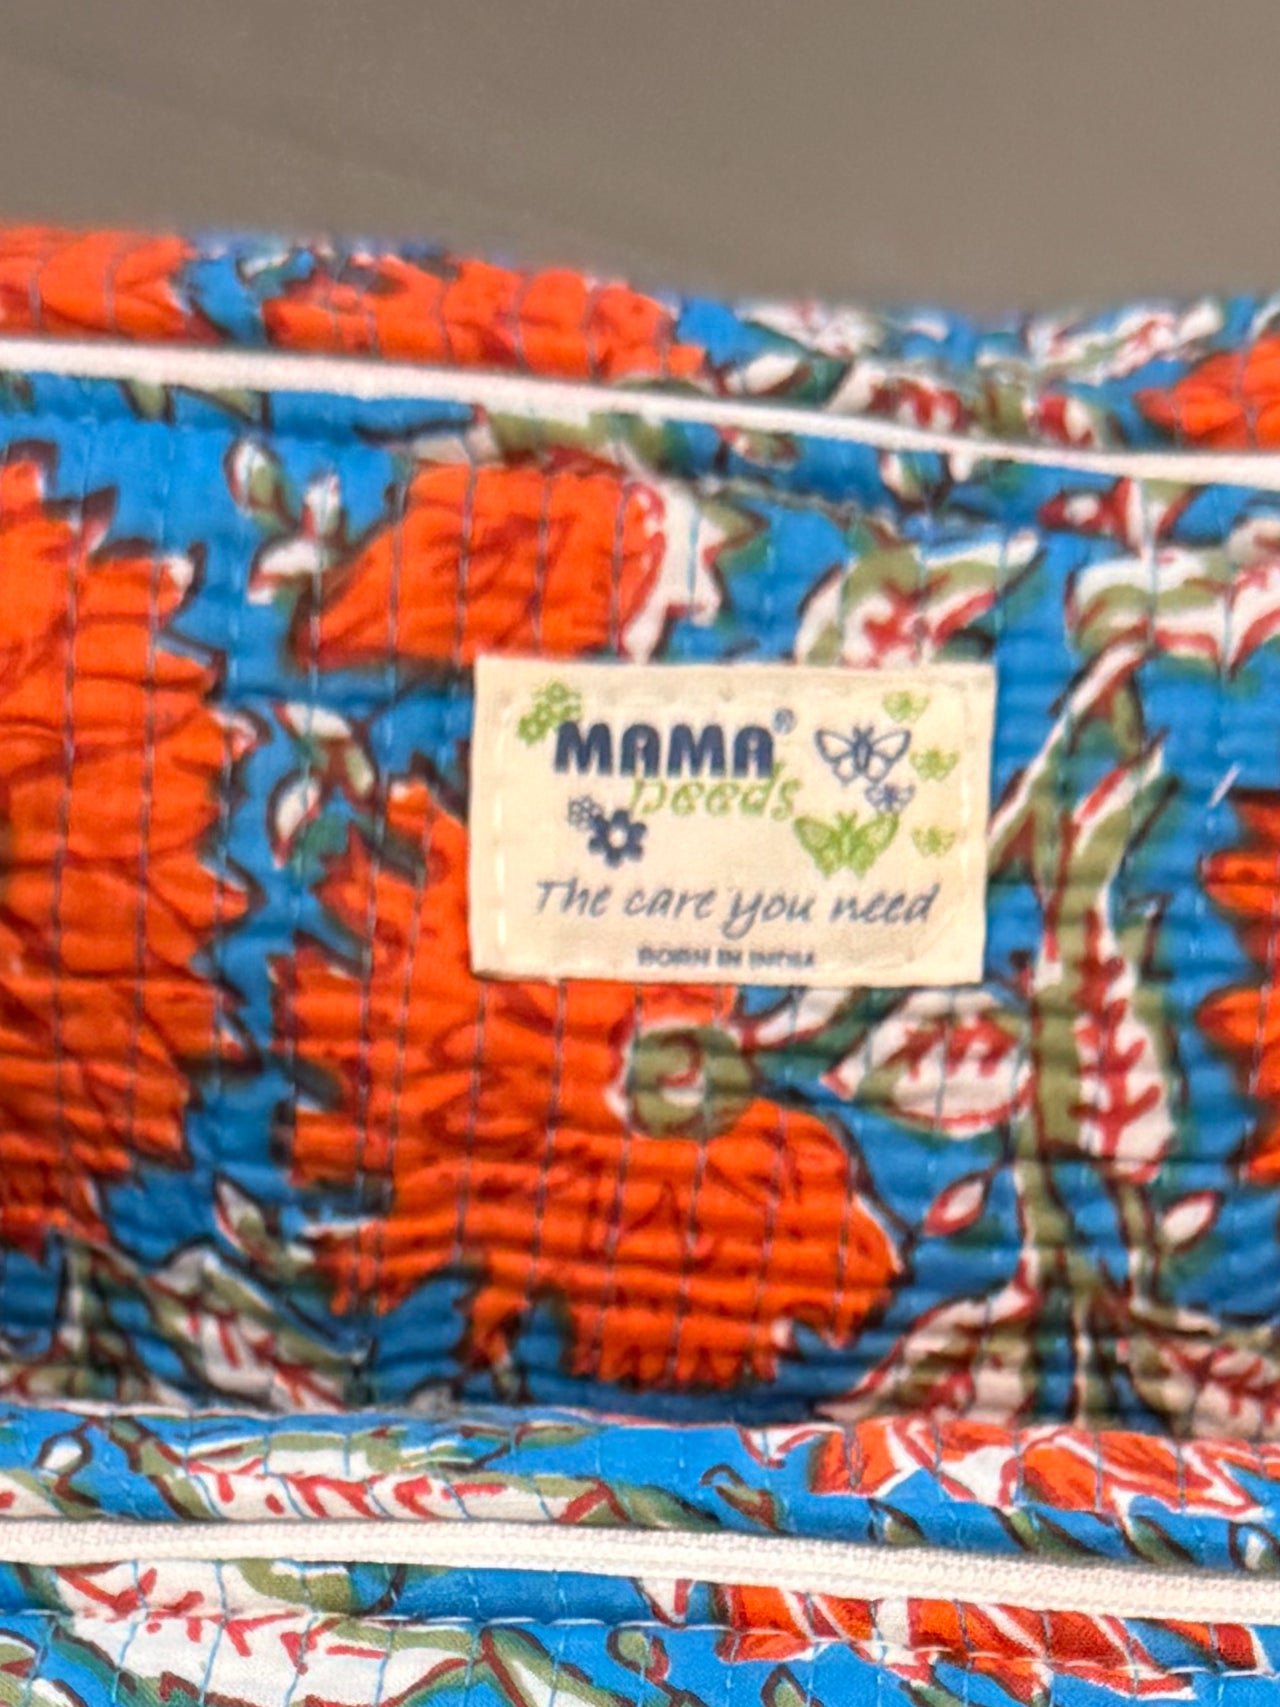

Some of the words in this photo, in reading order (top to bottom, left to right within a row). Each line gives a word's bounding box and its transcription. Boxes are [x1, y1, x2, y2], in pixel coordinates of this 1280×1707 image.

[555, 720, 773, 778] MAMA
[629, 761, 803, 820] needs
[535, 876, 613, 918] The
[623, 883, 718, 921] care
[719, 882, 817, 941] you
[829, 881, 941, 925] need
